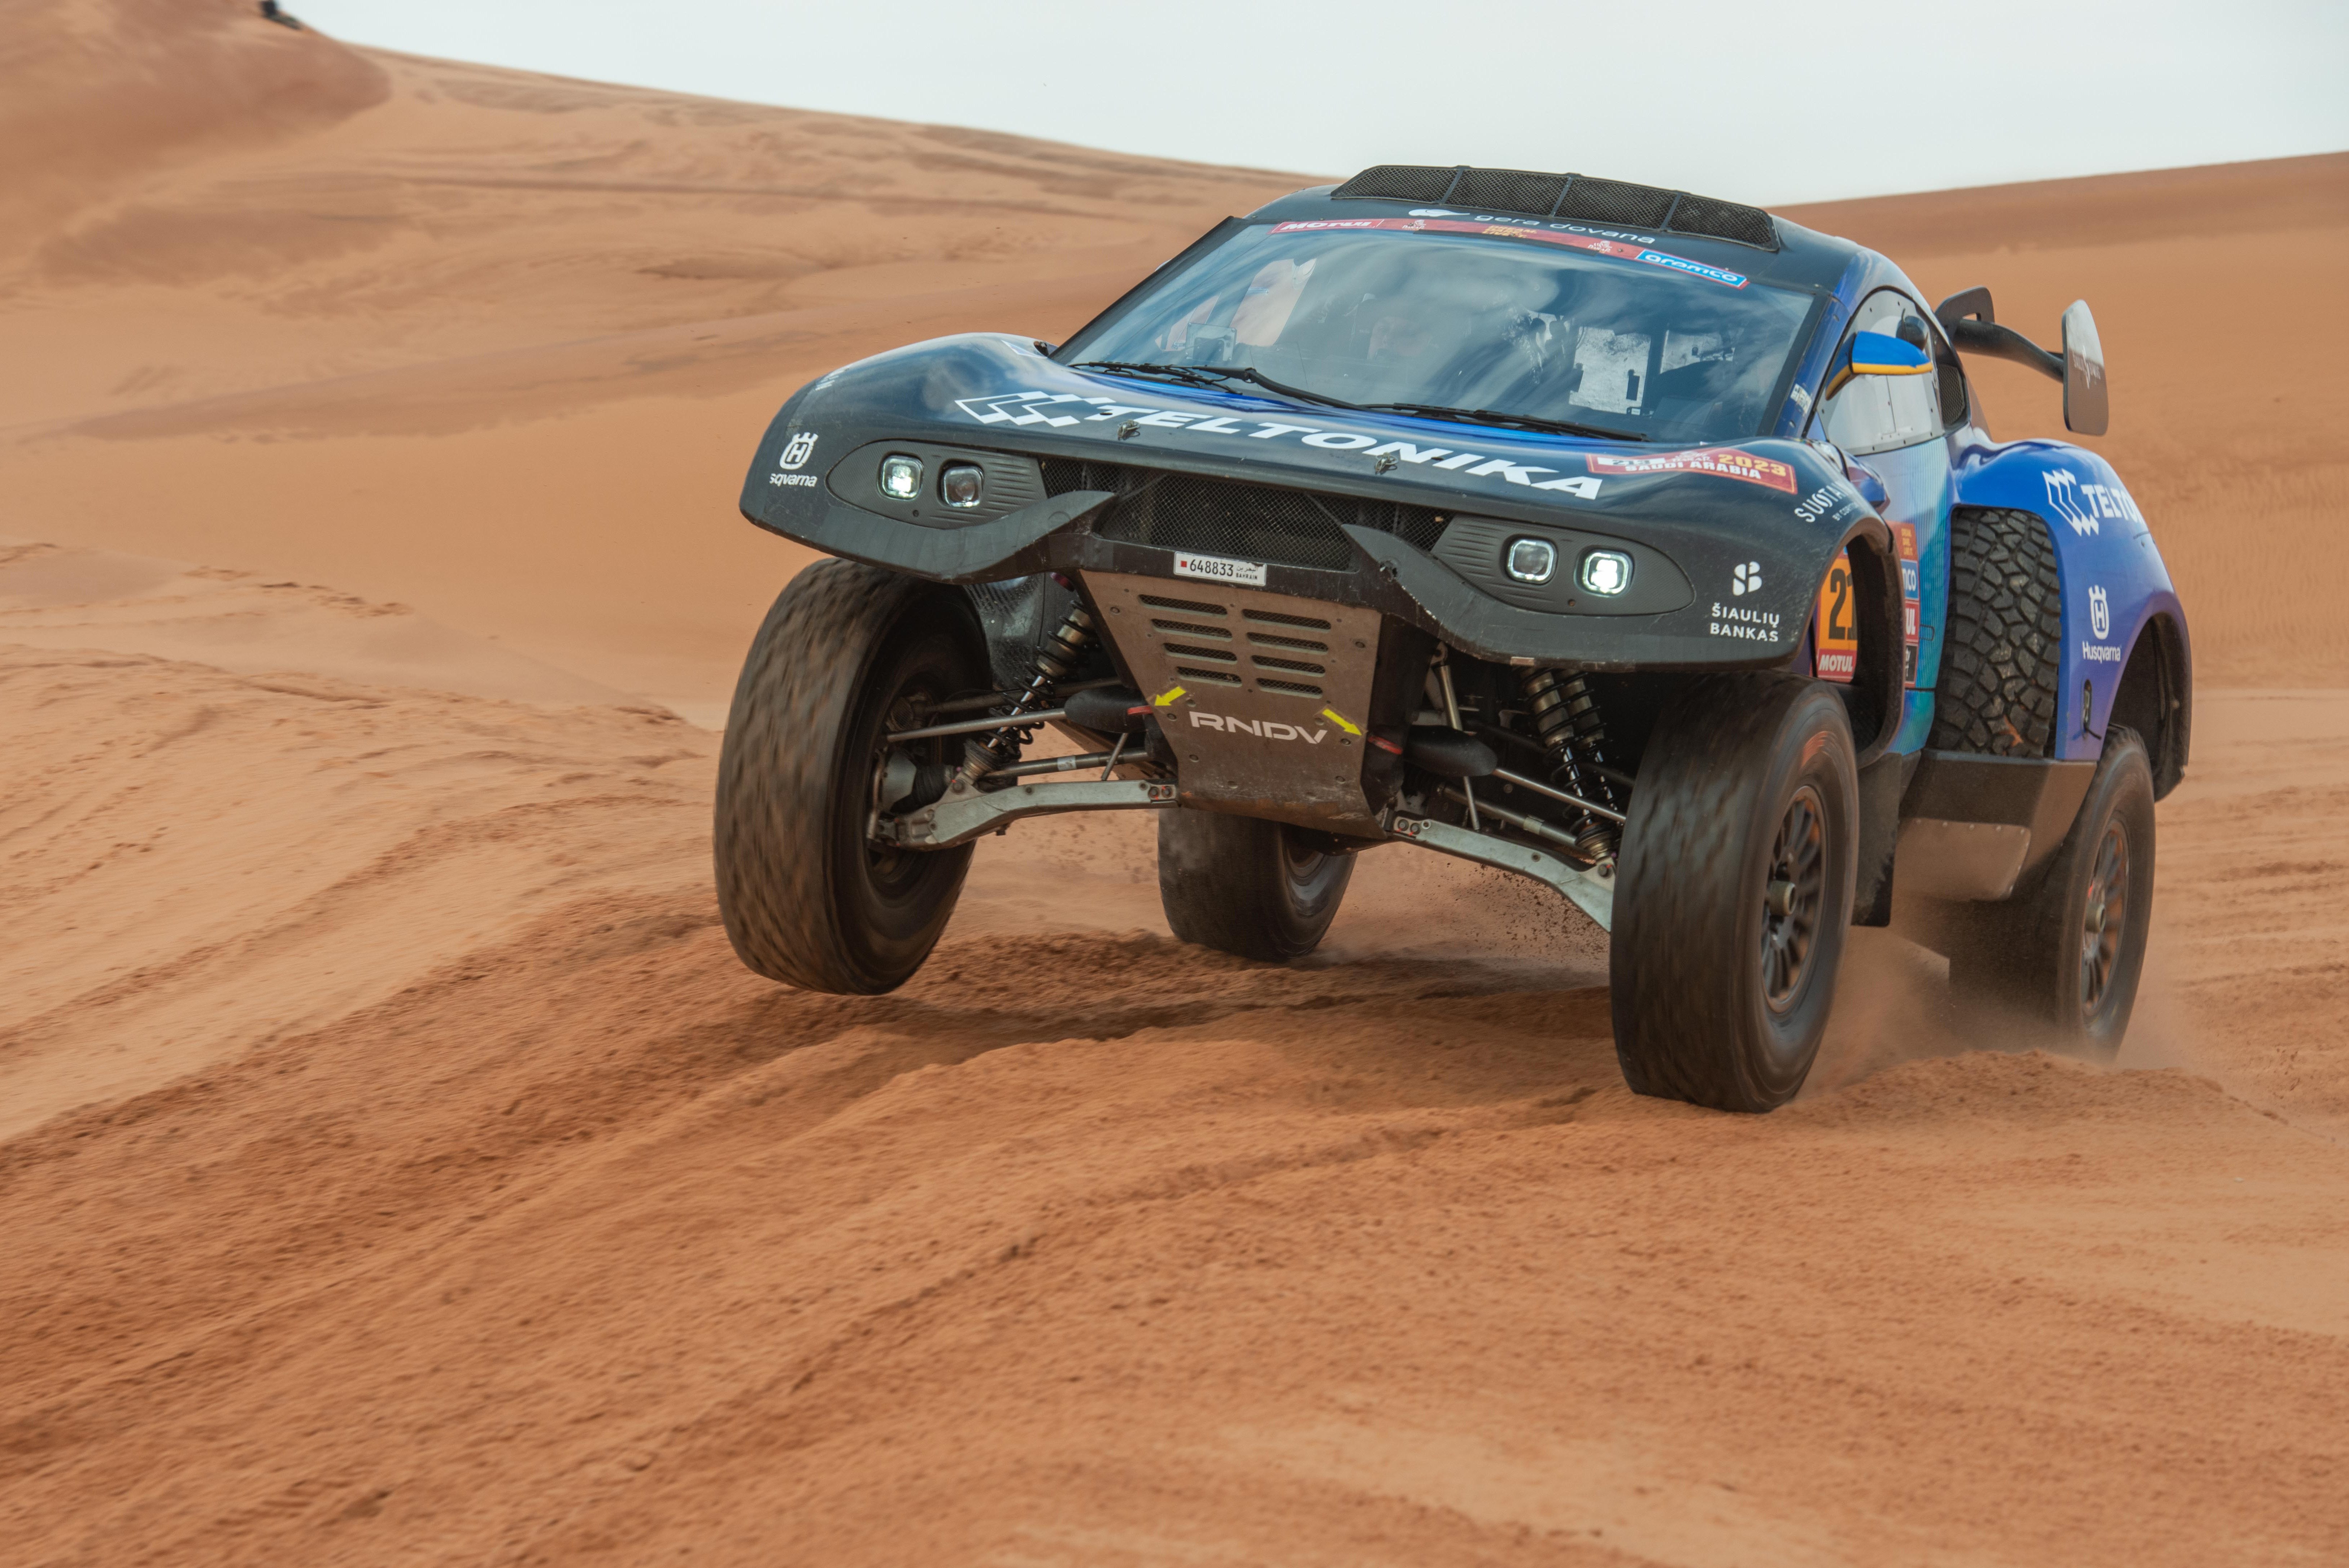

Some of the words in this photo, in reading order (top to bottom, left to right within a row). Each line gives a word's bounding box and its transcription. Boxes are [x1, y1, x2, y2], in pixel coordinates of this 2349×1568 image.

[1280, 222, 1372, 231] MOTUL
[1474, 215, 1540, 226] gera
[1550, 223, 1655, 244] dovana
[1084, 405, 1603, 500] TELTONIKA
[1625, 461, 1684, 471] SAUDI
[1690, 461, 1762, 480] ARABIA
[1718, 454, 1786, 477] 2023
[1190, 559, 1234, 577] 648833
[1712, 602, 1779, 628] ŠIAULIŲ
[1710, 622, 1779, 642] BANKAS
[1819, 654, 1853, 672] MOTUL
[2082, 640, 2121, 664] Husqvarna
[1189, 711, 1328, 744] RNDV
